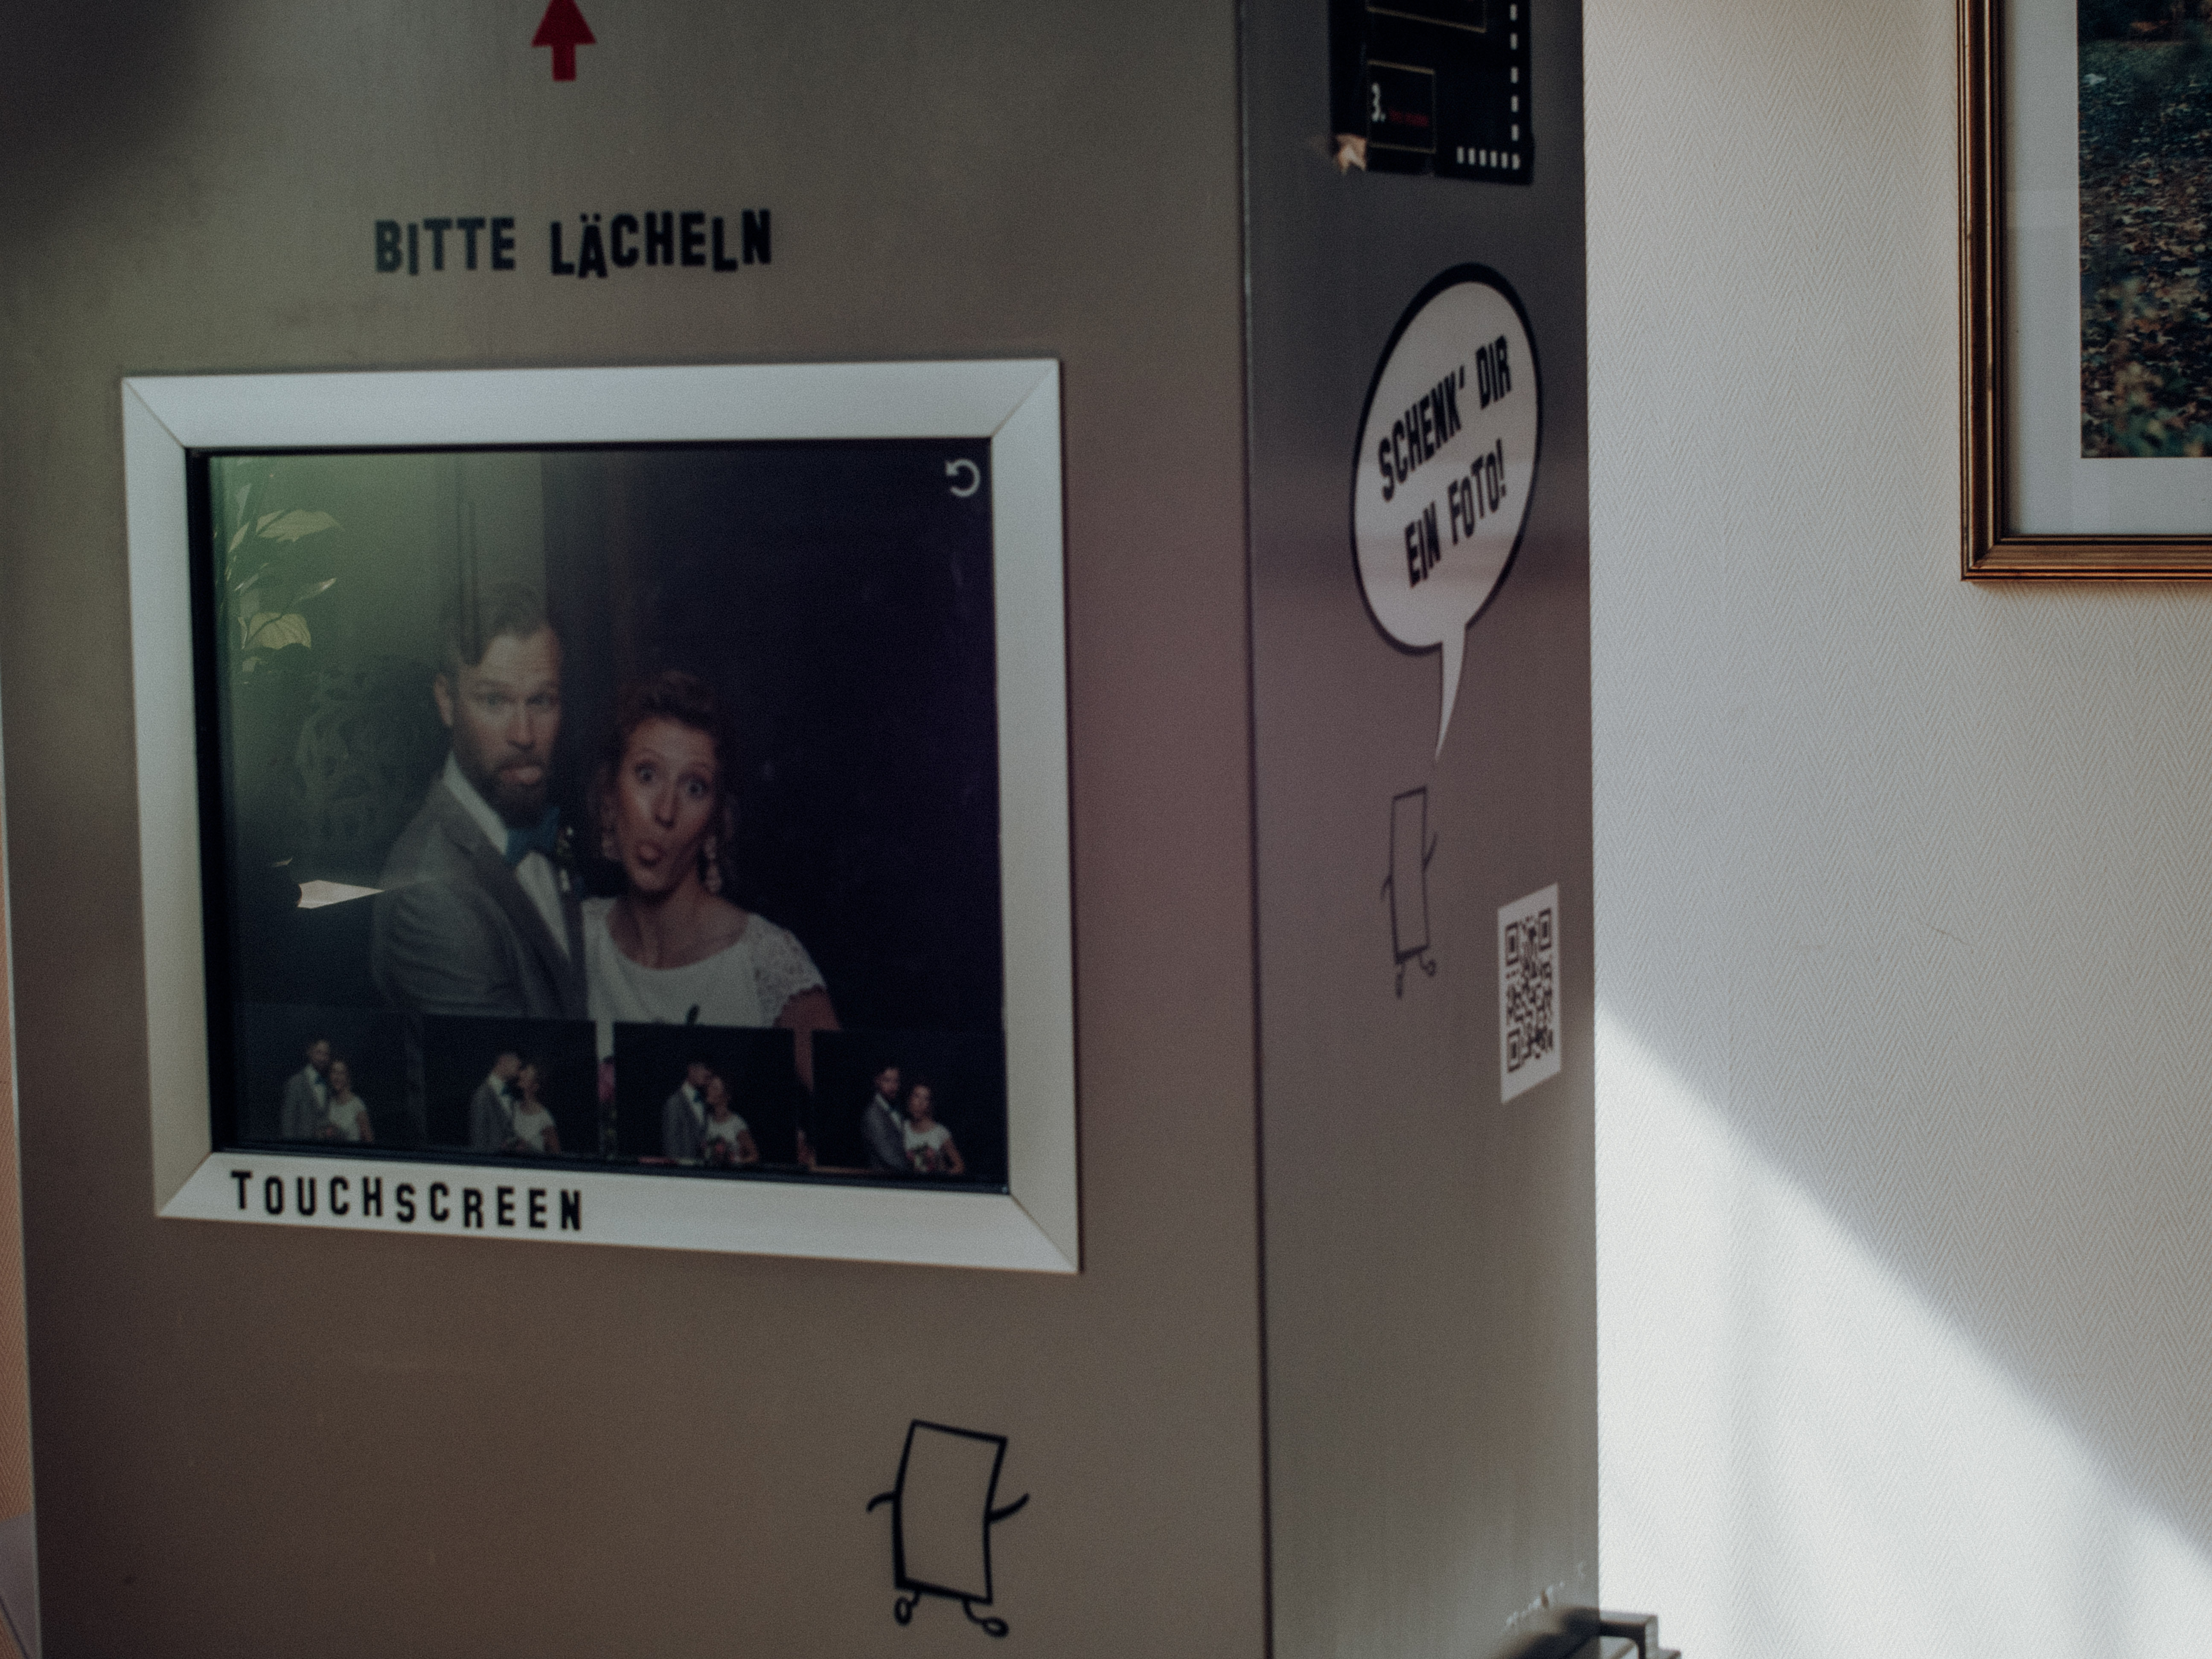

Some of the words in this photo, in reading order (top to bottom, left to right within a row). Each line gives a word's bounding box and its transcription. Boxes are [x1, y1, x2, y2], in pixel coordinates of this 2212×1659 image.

[1371, 82, 1386, 122] 3.
[375, 216, 515, 276] BITTE
[550, 209, 771, 279] LÄCHELN
[1378, 364, 1465, 503] SCHENK'
[1475, 335, 1511, 410] DIR
[1405, 501, 1441, 589] EIN
[1447, 437, 1507, 546] FOTO!
[230, 1170, 581, 1231] TOUCHSCREEN
